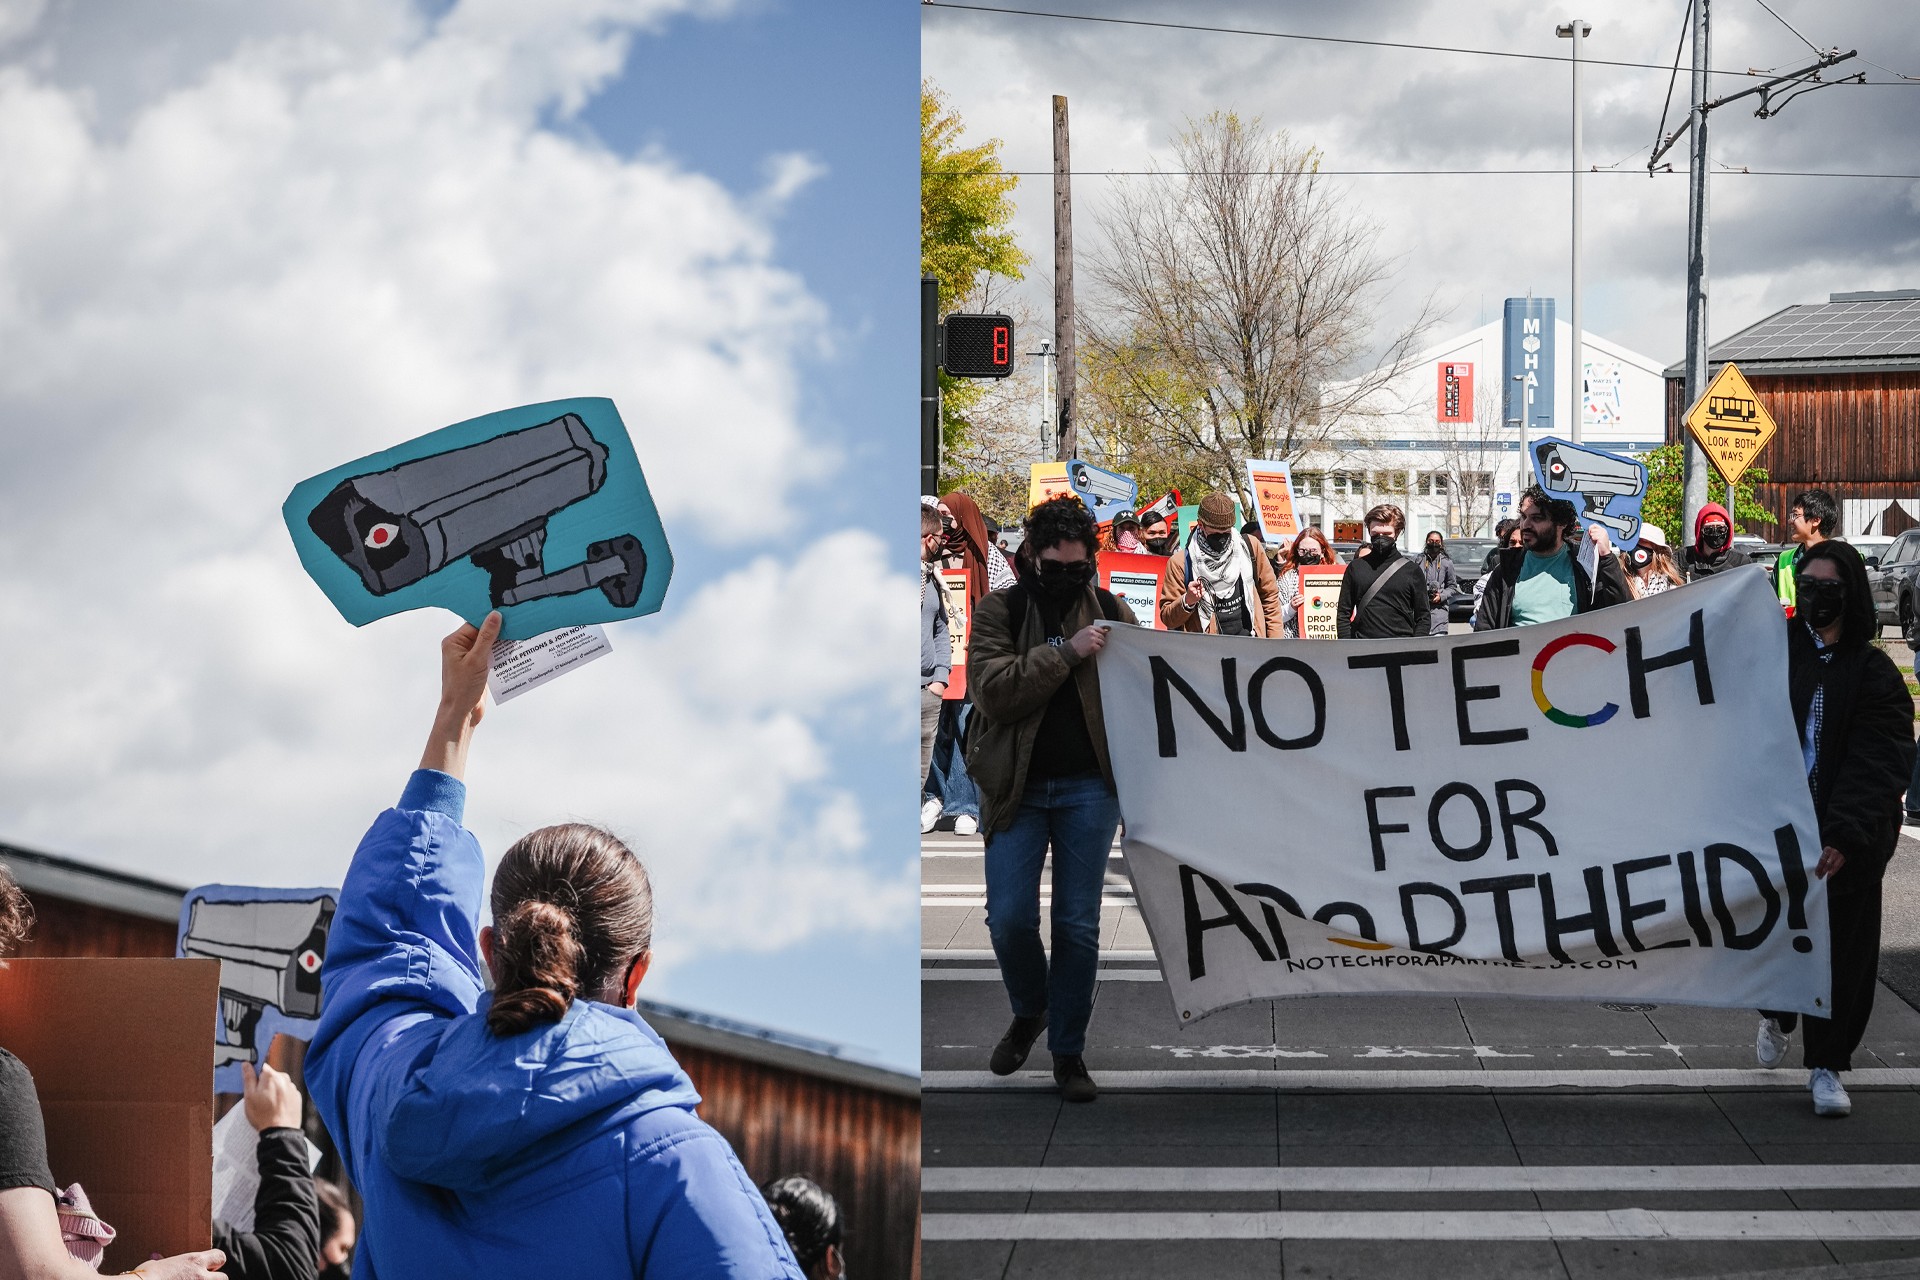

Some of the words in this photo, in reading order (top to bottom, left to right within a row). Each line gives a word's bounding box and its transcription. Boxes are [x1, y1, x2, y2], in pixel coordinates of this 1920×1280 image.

[993, 327, 1009, 365] 8
[1707, 436, 1729, 447] LOOK
[1735, 438, 1756, 449] BOTH
[1721, 450, 1743, 462] WAYS
[494, 660, 508, 671] SIGN
[508, 655, 519, 664] THE
[519, 641, 548, 659] PETITIONS
[555, 631, 569, 641] JOIN
[1150, 655, 1327, 758] NO
[1347, 608, 1715, 751] TECH
[1364, 778, 1559, 872] FOR
